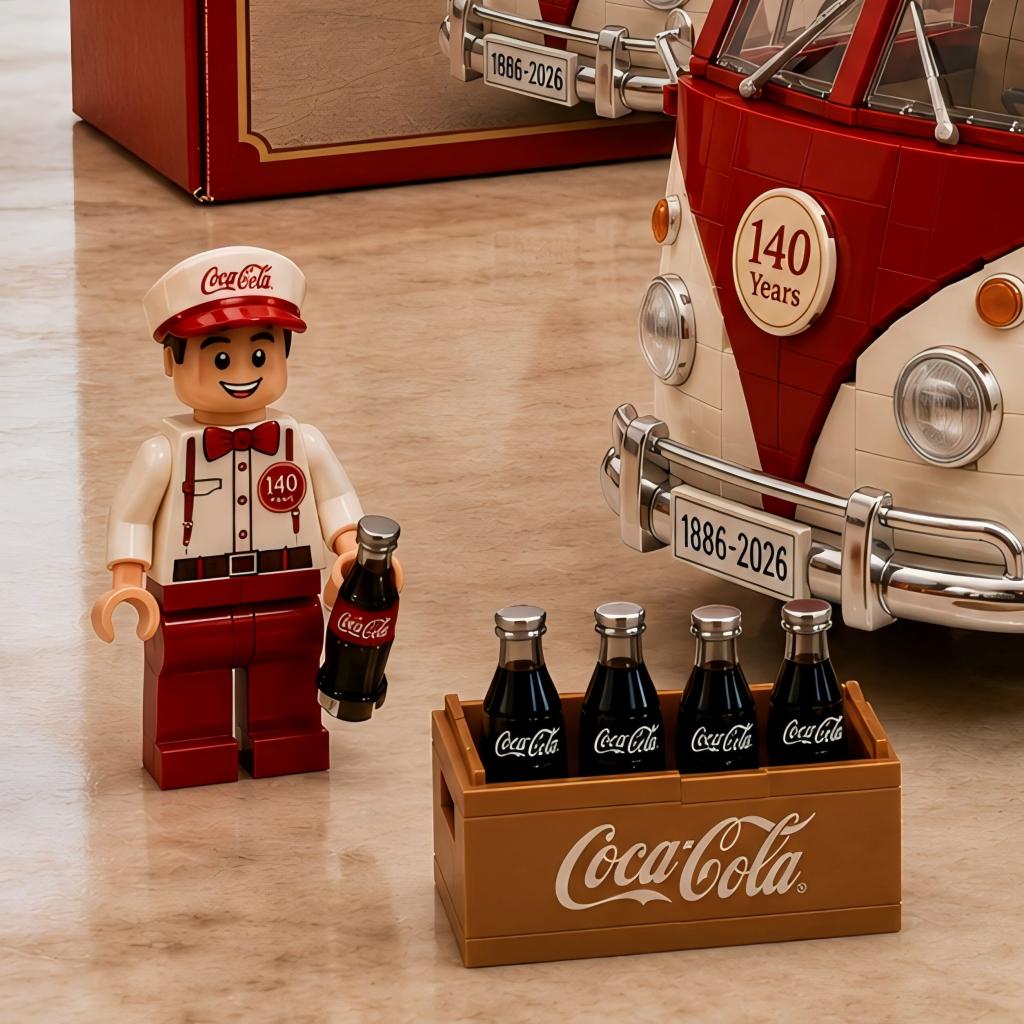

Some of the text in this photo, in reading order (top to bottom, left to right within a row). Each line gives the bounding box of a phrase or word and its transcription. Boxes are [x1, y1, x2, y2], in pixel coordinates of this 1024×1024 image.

[491, 52, 564, 92] 1886-2026
[748, 219, 812, 276] 140
[749, 271, 801, 307] Years
[266, 473, 298, 495] 140
[681, 514, 788, 582] 1886-2026
[555, 812, 816, 911] Coca-Cola
